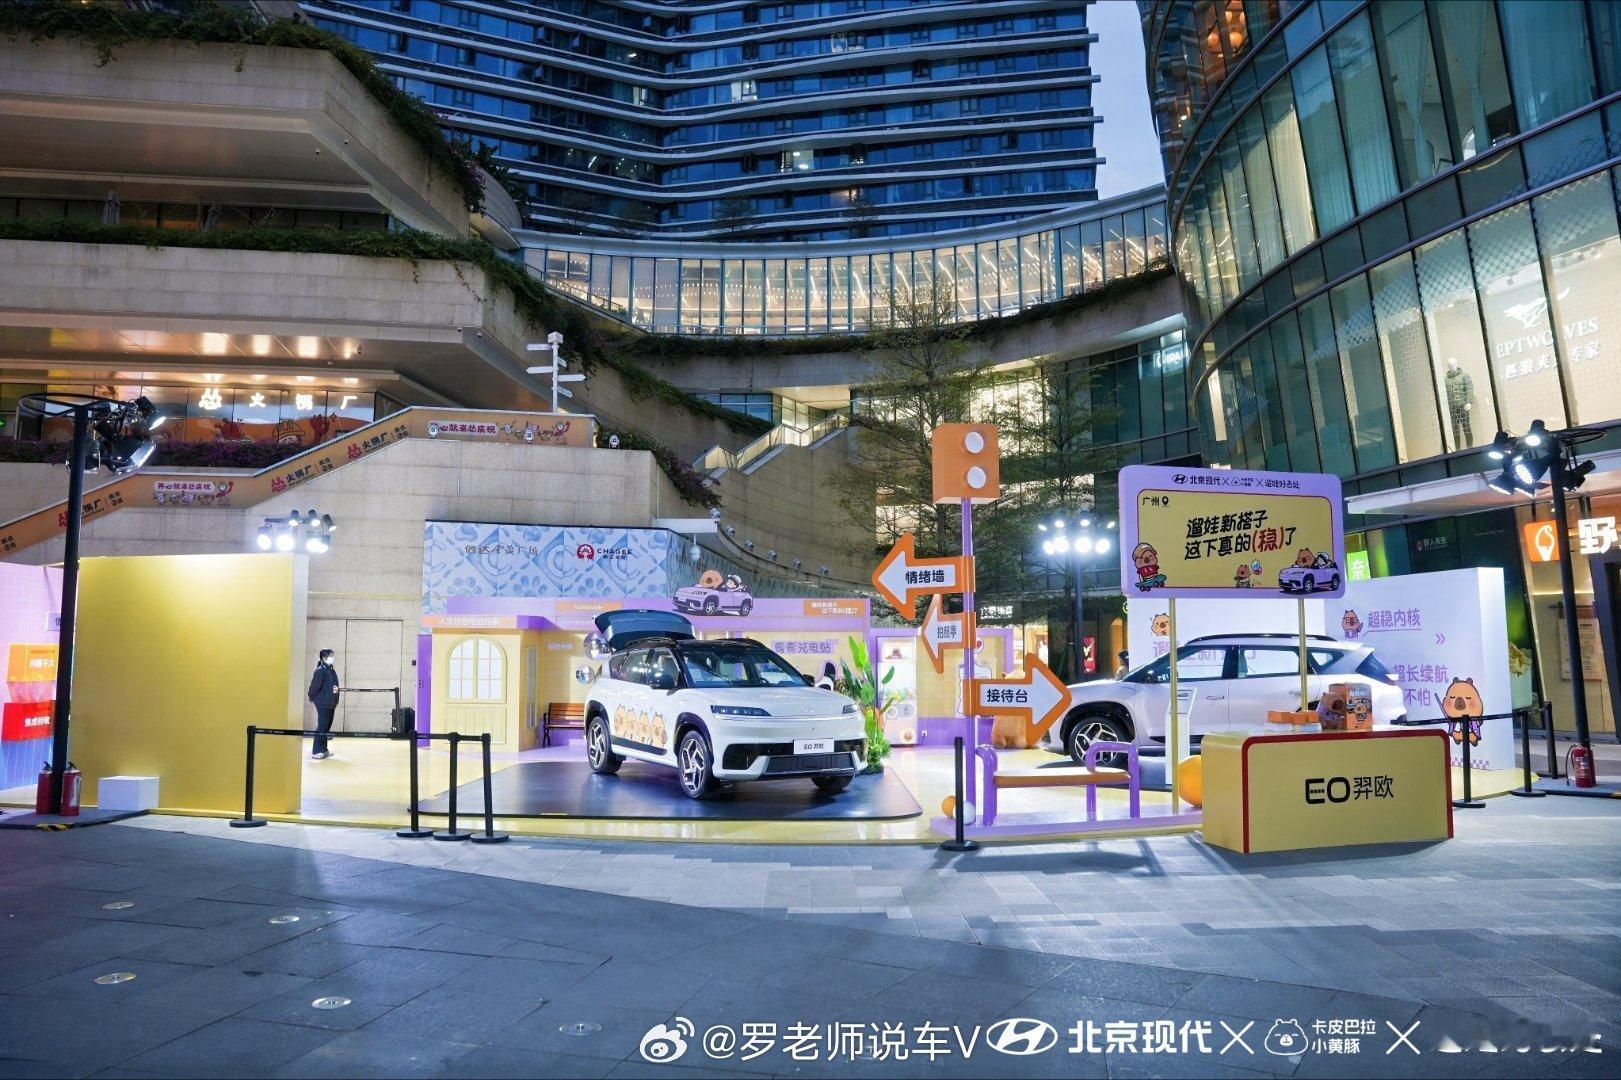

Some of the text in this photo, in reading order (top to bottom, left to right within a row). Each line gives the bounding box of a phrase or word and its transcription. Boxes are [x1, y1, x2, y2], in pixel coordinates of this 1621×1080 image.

[1496, 317, 1600, 359] EPTWOVES
[1189, 475, 1221, 486] 北京现代
[1142, 496, 1160, 507] 广州
[1186, 509, 1268, 539] 遛娃新搭子
[1185, 526, 1297, 561] 这下真的(稳)了
[1578, 516, 1619, 555] 野
[596, 548, 633, 556] CHAGEE
[906, 569, 945, 585] 情绪墙
[1368, 608, 1421, 629] 超稳内核
[1393, 664, 1449, 684] 超长续航
[986, 688, 1028, 704] 接待台
[1305, 775, 1394, 805] EO 羿欧
